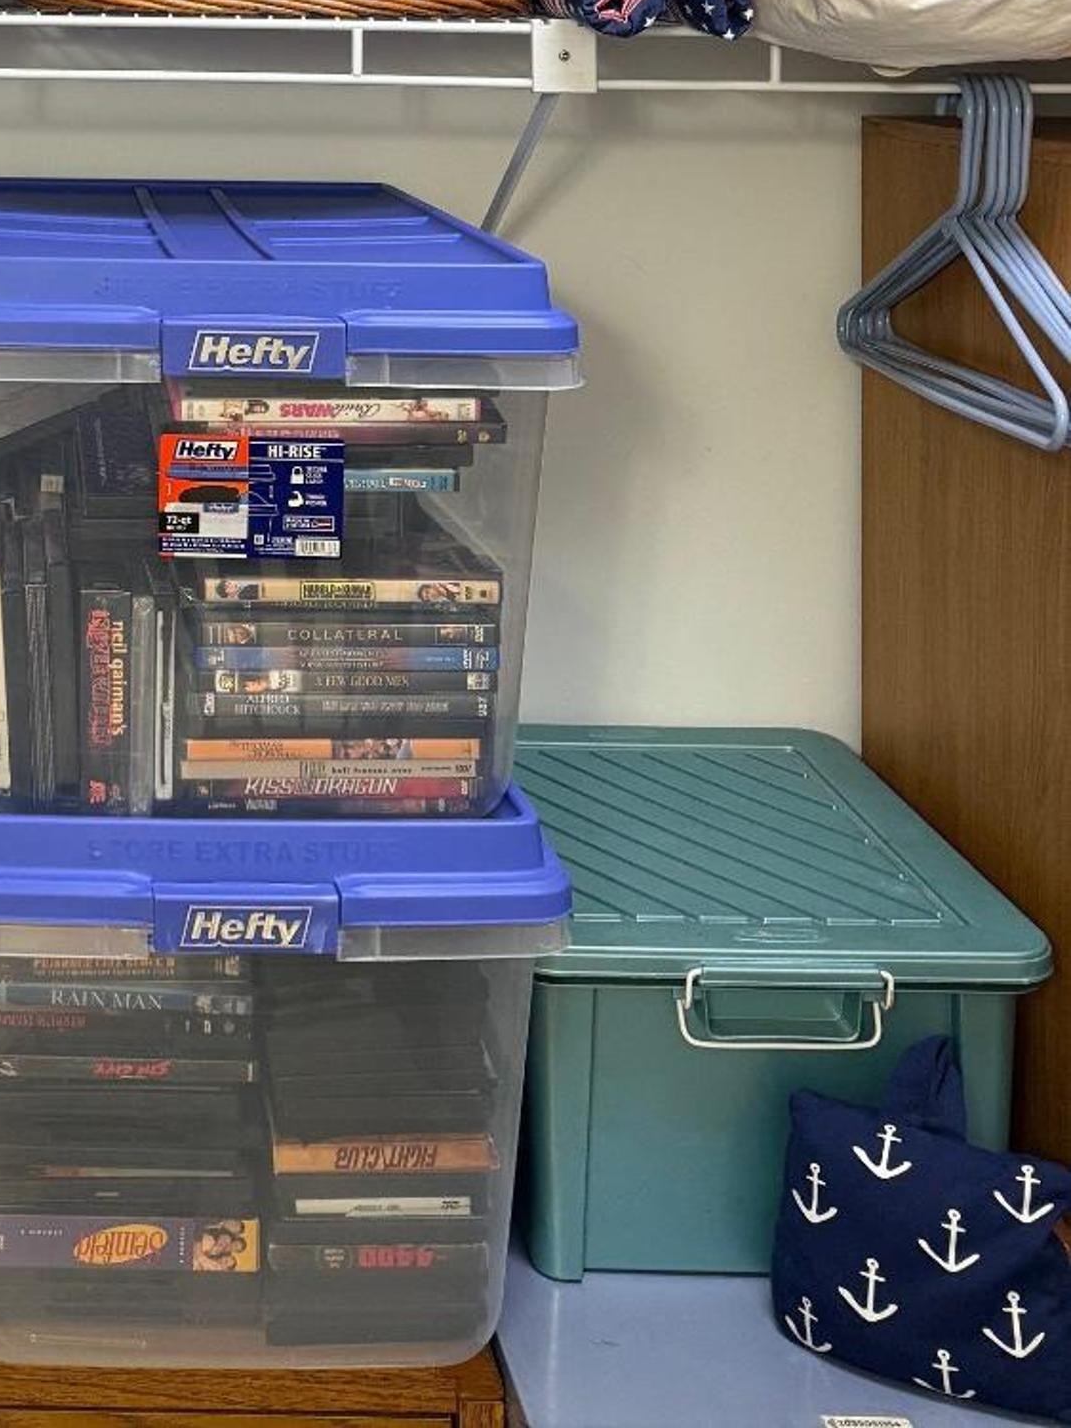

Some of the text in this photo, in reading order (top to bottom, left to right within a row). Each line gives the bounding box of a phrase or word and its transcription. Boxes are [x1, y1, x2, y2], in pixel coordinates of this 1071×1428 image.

[199, 336, 311, 370] Hefty
[178, 441, 236, 460] Hefty
[268, 444, 323, 459] HI-RISE
[288, 629, 404, 641] COLLATERAL
[109, 621, 128, 735] neil gaiman's
[234, 703, 300, 716] HITCHCOCK
[245, 778, 293, 795] KISS
[313, 778, 398, 795] DRAGON
[194, 840, 294, 865] EXTRA
[191, 911, 302, 945] Hefty
[51, 989, 164, 1011] RAIN MAN
[333, 1145, 438, 1169] FIGHT CLUB
